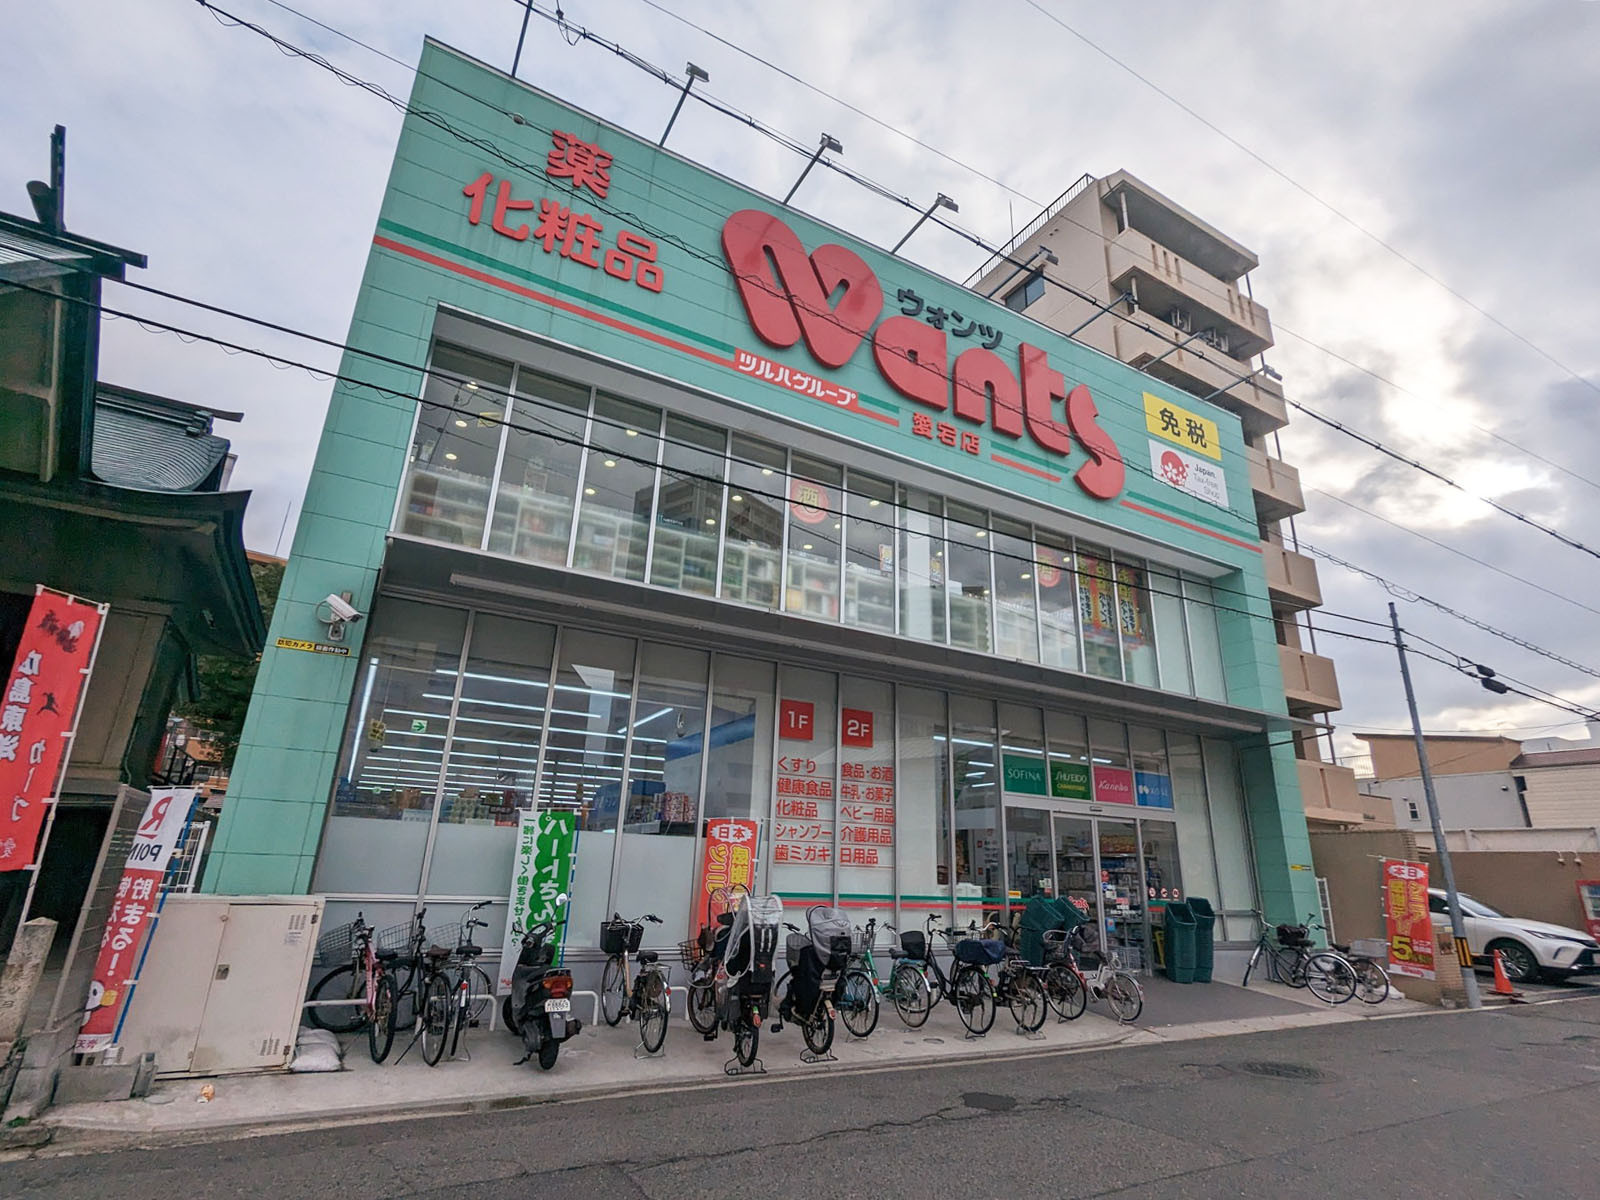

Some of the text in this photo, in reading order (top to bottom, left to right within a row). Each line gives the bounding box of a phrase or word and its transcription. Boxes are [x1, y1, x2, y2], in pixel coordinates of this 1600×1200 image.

[546, 129, 614, 199] 薬
[462, 171, 665, 293] 化粧品
[721, 208, 1125, 500] Wants
[738, 352, 858, 407] ツルハグループ
[911, 411, 982, 456] 愛宕店
[1159, 408, 1207, 448] 免税
[788, 711, 809, 729] 1F
[847, 719, 870, 737] 2F
[778, 756, 816, 774] くすり
[841, 762, 894, 782] 食品・お酒
[1007, 768, 1041, 782] SOFINA
[777, 777, 833, 798] 健康食品
[841, 784, 894, 803] 牛乳・お菓子
[1098, 780, 1129, 793] Kanebo
[776, 799, 818, 818] 化粧品
[840, 805, 895, 824] ベビー用品
[776, 823, 833, 839] シャンプー
[840, 825, 893, 844] 介護用品
[774, 844, 831, 862] 歯ミガキ
[839, 847, 879, 865] 日用品
